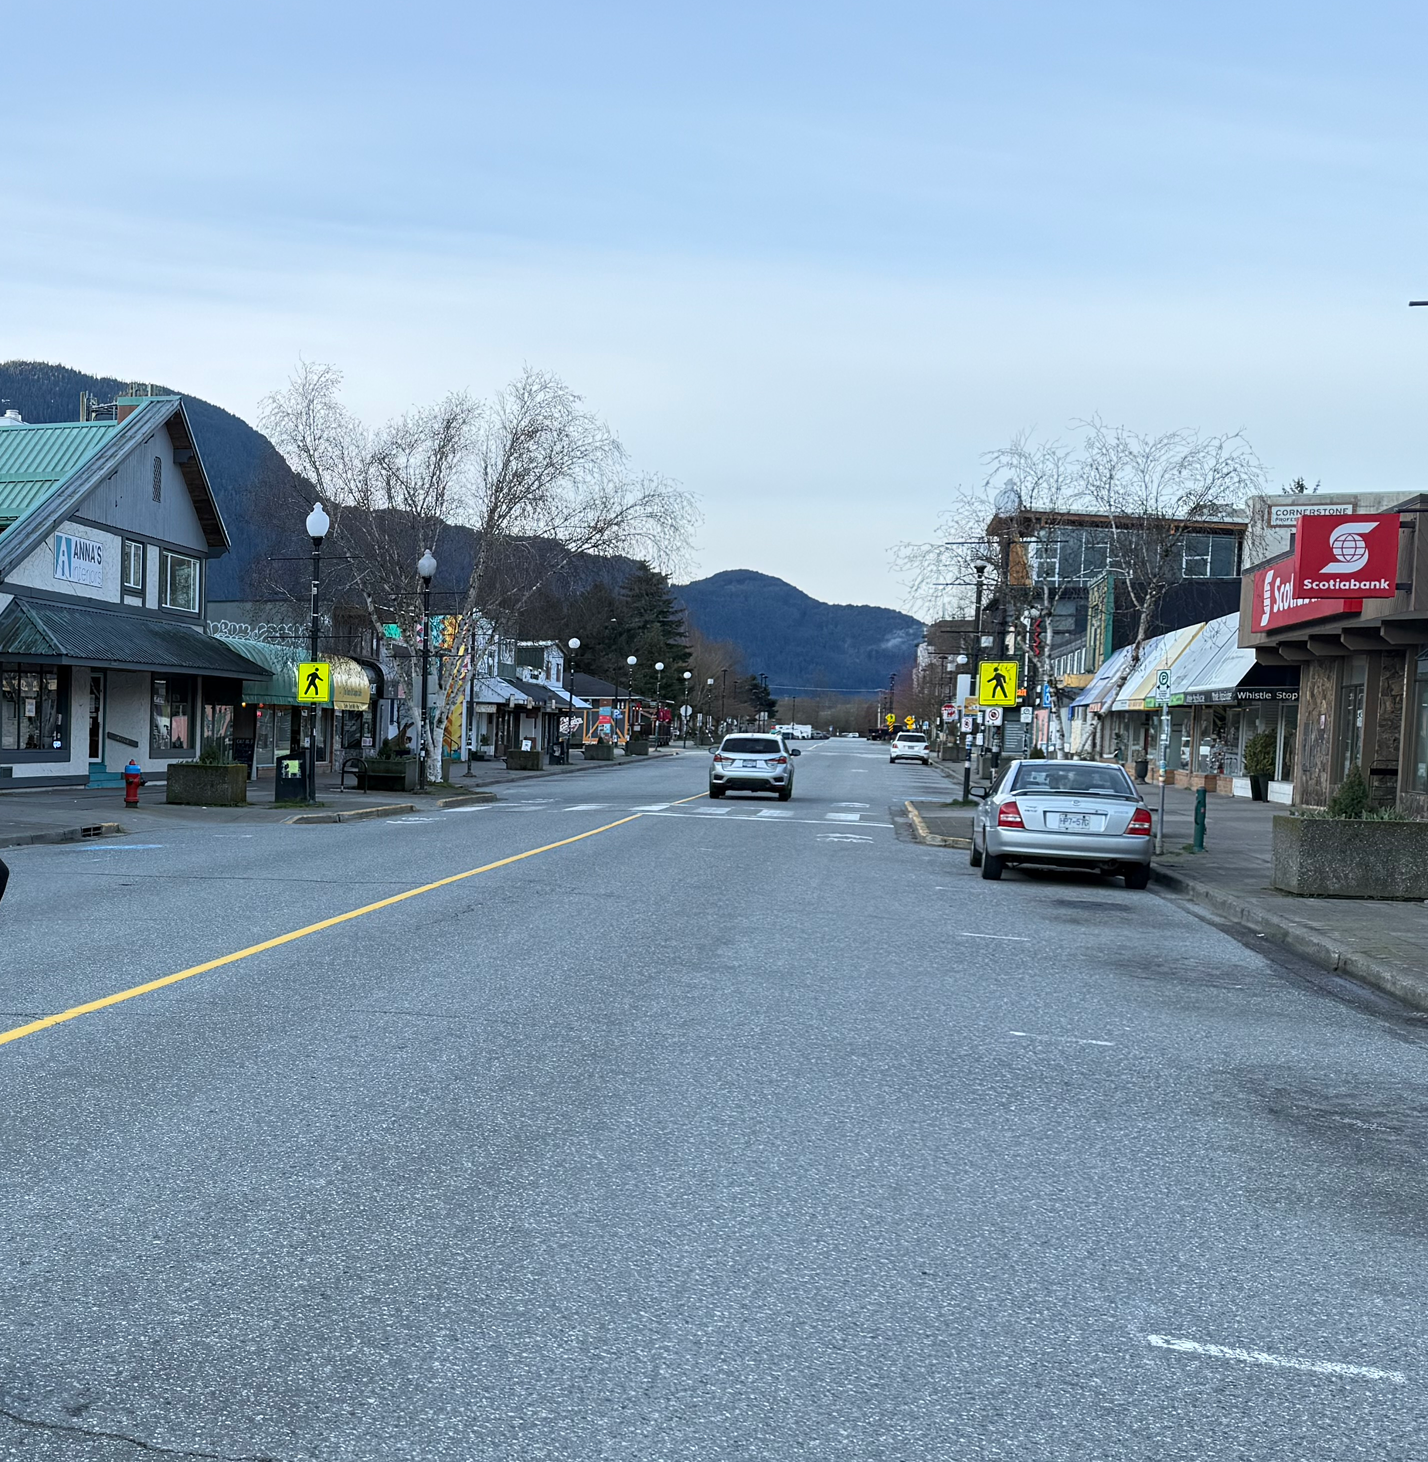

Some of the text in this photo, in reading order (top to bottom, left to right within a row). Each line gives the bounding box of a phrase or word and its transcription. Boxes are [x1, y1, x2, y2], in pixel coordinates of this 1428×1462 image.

[1275, 507, 1349, 517] CORNERSTONE
[73, 540, 102, 565] ANNA'S
[1303, 578, 1390, 590] Scotiabank
[1237, 691, 1272, 700] Whistle
[1276, 691, 1299, 701] Stop
